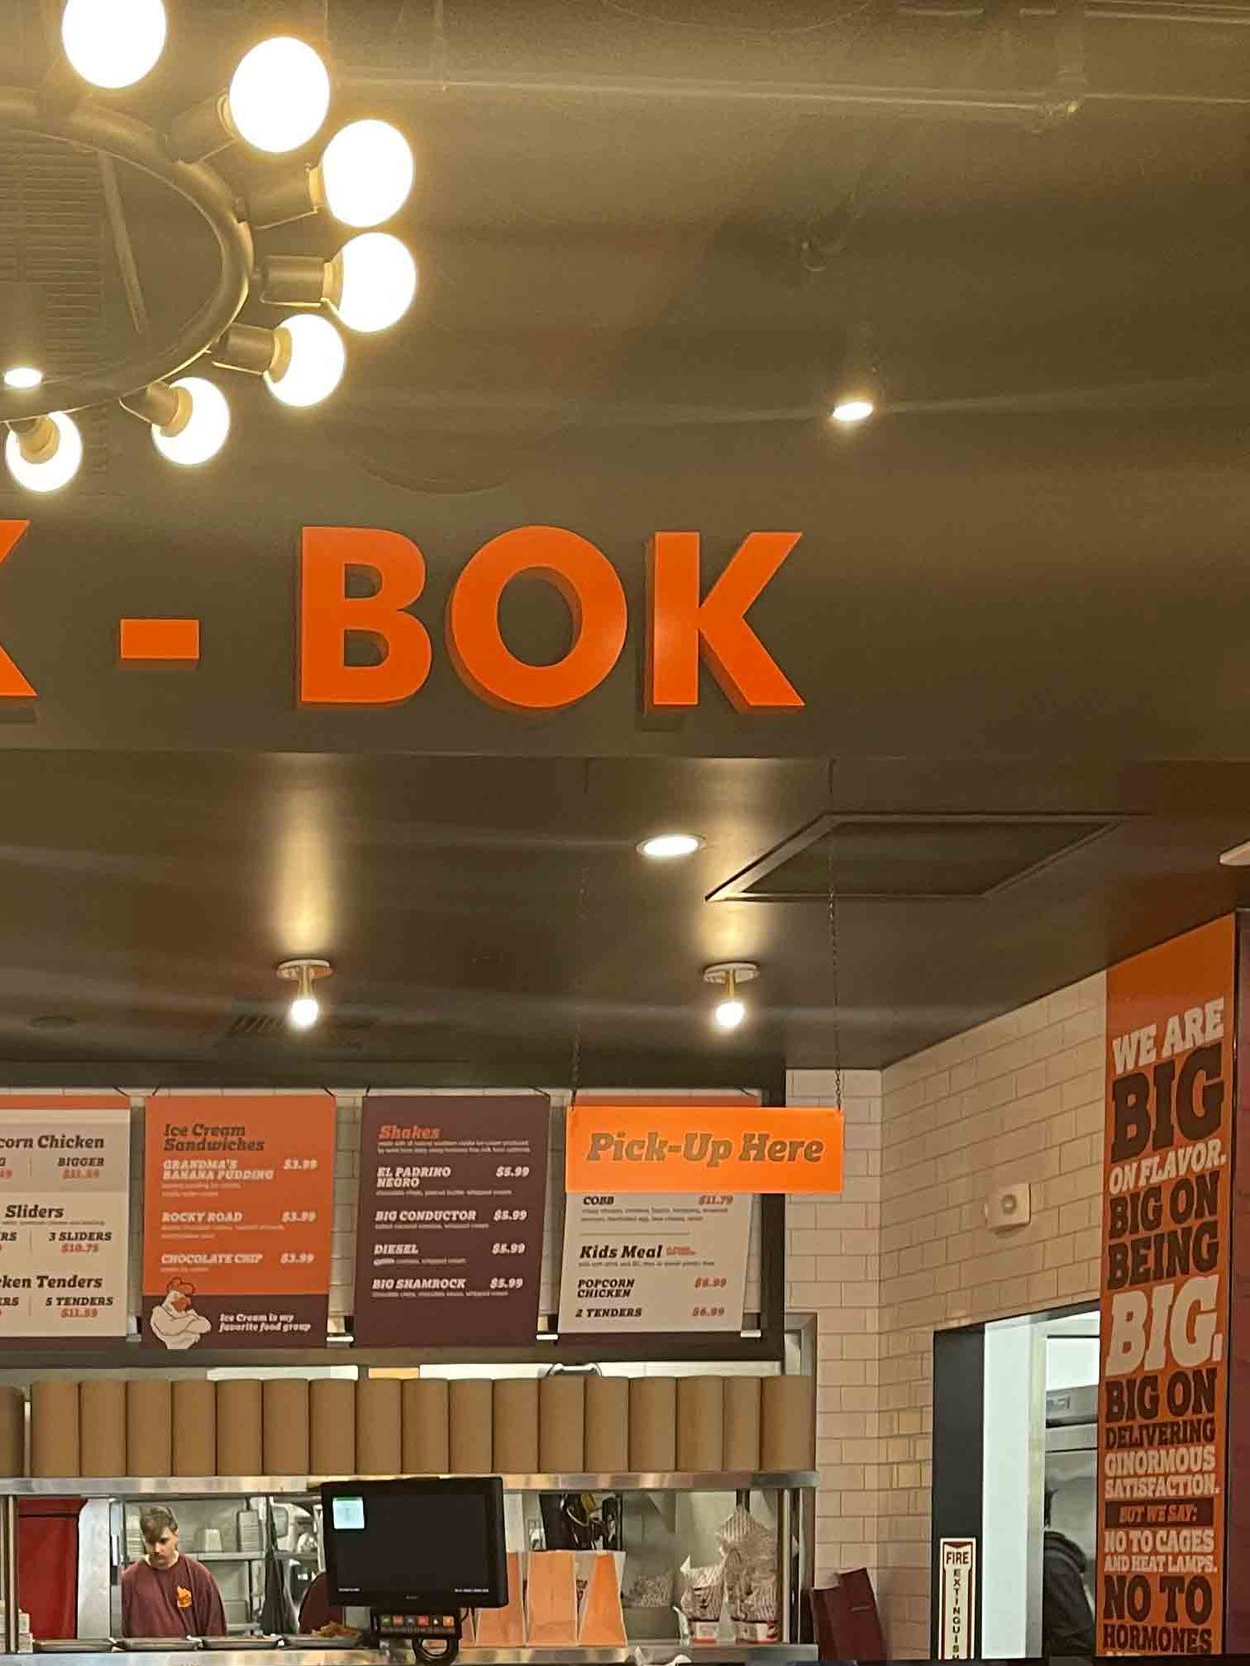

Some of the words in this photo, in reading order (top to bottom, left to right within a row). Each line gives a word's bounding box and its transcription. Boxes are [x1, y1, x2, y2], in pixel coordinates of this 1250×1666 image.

[299, 526, 807, 710] BOK
[1112, 1023, 1156, 1075] WE
[1162, 997, 1224, 1058] ARE
[1111, 1042, 1224, 1163] BIG
[164, 1124, 188, 1137] Ice
[192, 1123, 245, 1137] Cream
[379, 1125, 441, 1140] Shakes
[37, 1134, 104, 1148] Chicken
[163, 1137, 265, 1151] Sandwiches
[586, 1131, 733, 1167] Pick-Up
[738, 1132, 825, 1162] Here
[57, 1157, 105, 1167] BIGGER
[1110, 1162, 1139, 1194] ON
[1139, 1138, 1227, 1187] FLAVOR.
[163, 1170, 215, 1180] BANANA
[217, 1170, 274, 1180] PUDDING
[377, 1167, 393, 1177] EL
[496, 1166, 529, 1178] $5.99
[377, 1177, 420, 1188] NEGRO
[583, 1196, 615, 1205] COBB
[1110, 1186, 1163, 1239] BIG
[1170, 1170, 1220, 1224] ON
[5, 1205, 64, 1219] Sliders
[162, 1212, 205, 1223] ROCKY
[207, 1212, 243, 1223] ROAD
[375, 1211, 398, 1221] BIG
[400, 1210, 477, 1221] CONDUCTOR
[493, 1210, 527, 1221] $5.99
[49, 1232, 56, 1241] 3
[58, 1232, 112, 1241] SLIDERS
[374, 1244, 419, 1255] DIESEL
[492, 1243, 526, 1254] $5.99
[580, 1245, 618, 1259] Kids
[621, 1244, 663, 1259] Meal
[1108, 1221, 1220, 1290] BEING
[161, 1254, 234, 1264] CHOCOLATE
[37, 1275, 103, 1289] Tenders
[372, 1279, 395, 1289] BIG
[395, 1279, 467, 1289] SHAMROCK
[490, 1278, 523, 1289] $5.99
[578, 1278, 635, 1288] POPCORN
[578, 1289, 631, 1298] CHICKEN
[46, 1297, 53, 1306] 5
[56, 1297, 113, 1306] TENDERS
[576, 1308, 582, 1317] 2
[586, 1308, 642, 1317] TENDERS
[1105, 1274, 1223, 1377] BIG.
[1106, 1376, 1159, 1423] BIG
[1167, 1367, 1217, 1416] ON
[1106, 1418, 1215, 1449] DELIVERING
[1105, 1445, 1215, 1477] GINORMOUS
[1105, 1473, 1221, 1498] SATISFACTION.
[1119, 1506, 1145, 1522] BUT
[1147, 1505, 1166, 1521] WE
[1168, 1504, 1198, 1521] SAY:
[1105, 1531, 1127, 1552] NO
[1129, 1531, 1153, 1552] TO
[1155, 1530, 1214, 1552] CAGES
[946, 1552, 969, 1565] FIRE
[1105, 1556, 1129, 1572] AND
[1131, 1556, 1166, 1572] HEAT
[1168, 1556, 1217, 1573] LAMPS.
[1103, 1575, 1151, 1622] NO
[1160, 1575, 1212, 1625] TO
[1103, 1623, 1212, 1654] HORMONES
